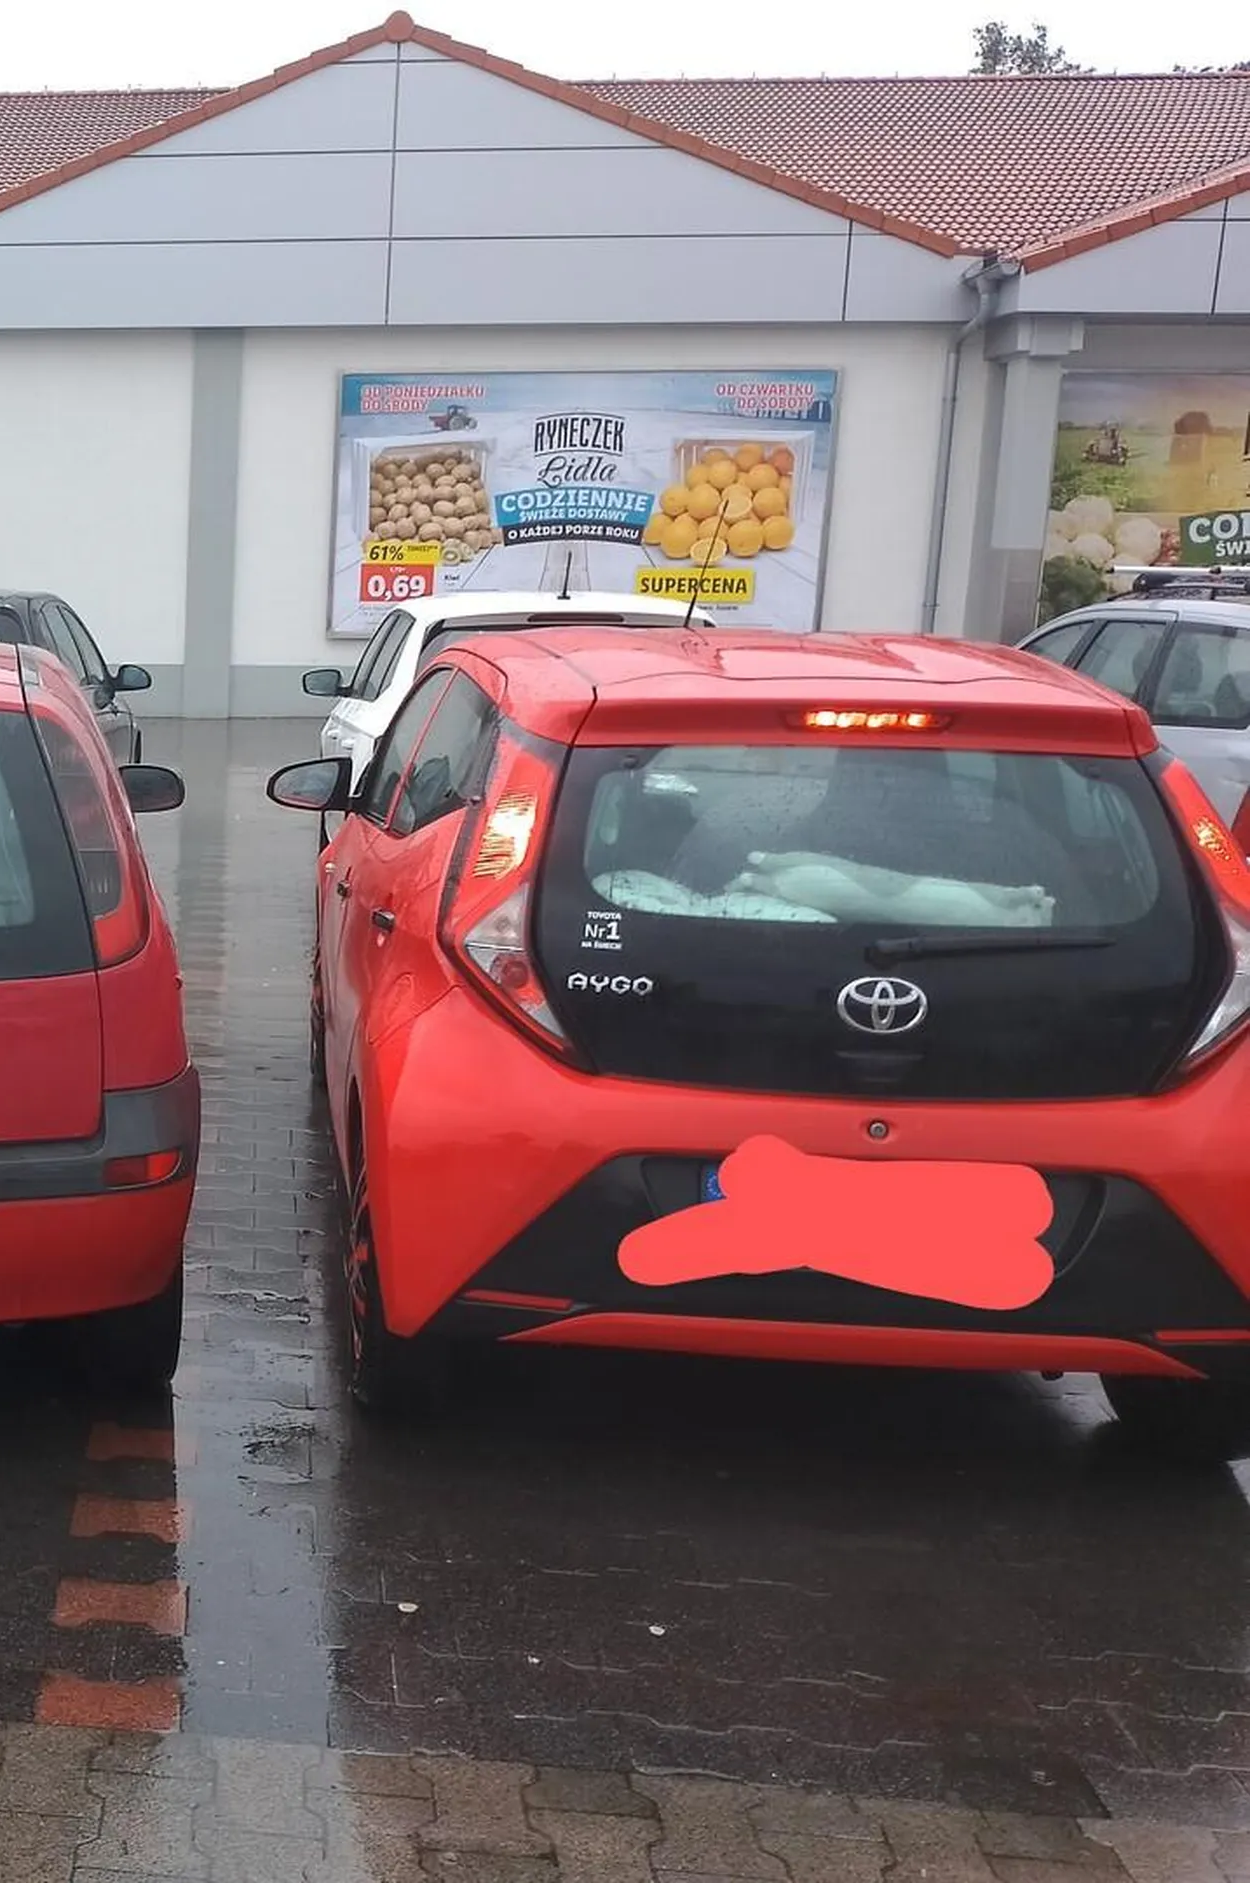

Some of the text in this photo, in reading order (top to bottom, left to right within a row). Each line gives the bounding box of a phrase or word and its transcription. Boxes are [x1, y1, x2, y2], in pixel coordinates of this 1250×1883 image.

[716, 383, 814, 396] OD CZWARTKU
[362, 400, 381, 411] DO
[737, 397, 815, 409] DO SOBOTY
[534, 416, 625, 452] RYNECZEK
[537, 455, 617, 489] Lidla
[501, 490, 649, 513] CODZIENNIE
[518, 506, 630, 523] ŚWIEŻE DOSTAWY
[507, 524, 640, 540] O KAŻDEJ PORZE ROKU
[369, 545, 404, 560] 61%
[367, 574, 427, 601] 0,69
[640, 577, 748, 594] SUPERCENA
[587, 911, 622, 921] TOYOTA
[568, 972, 653, 996] AYGO
